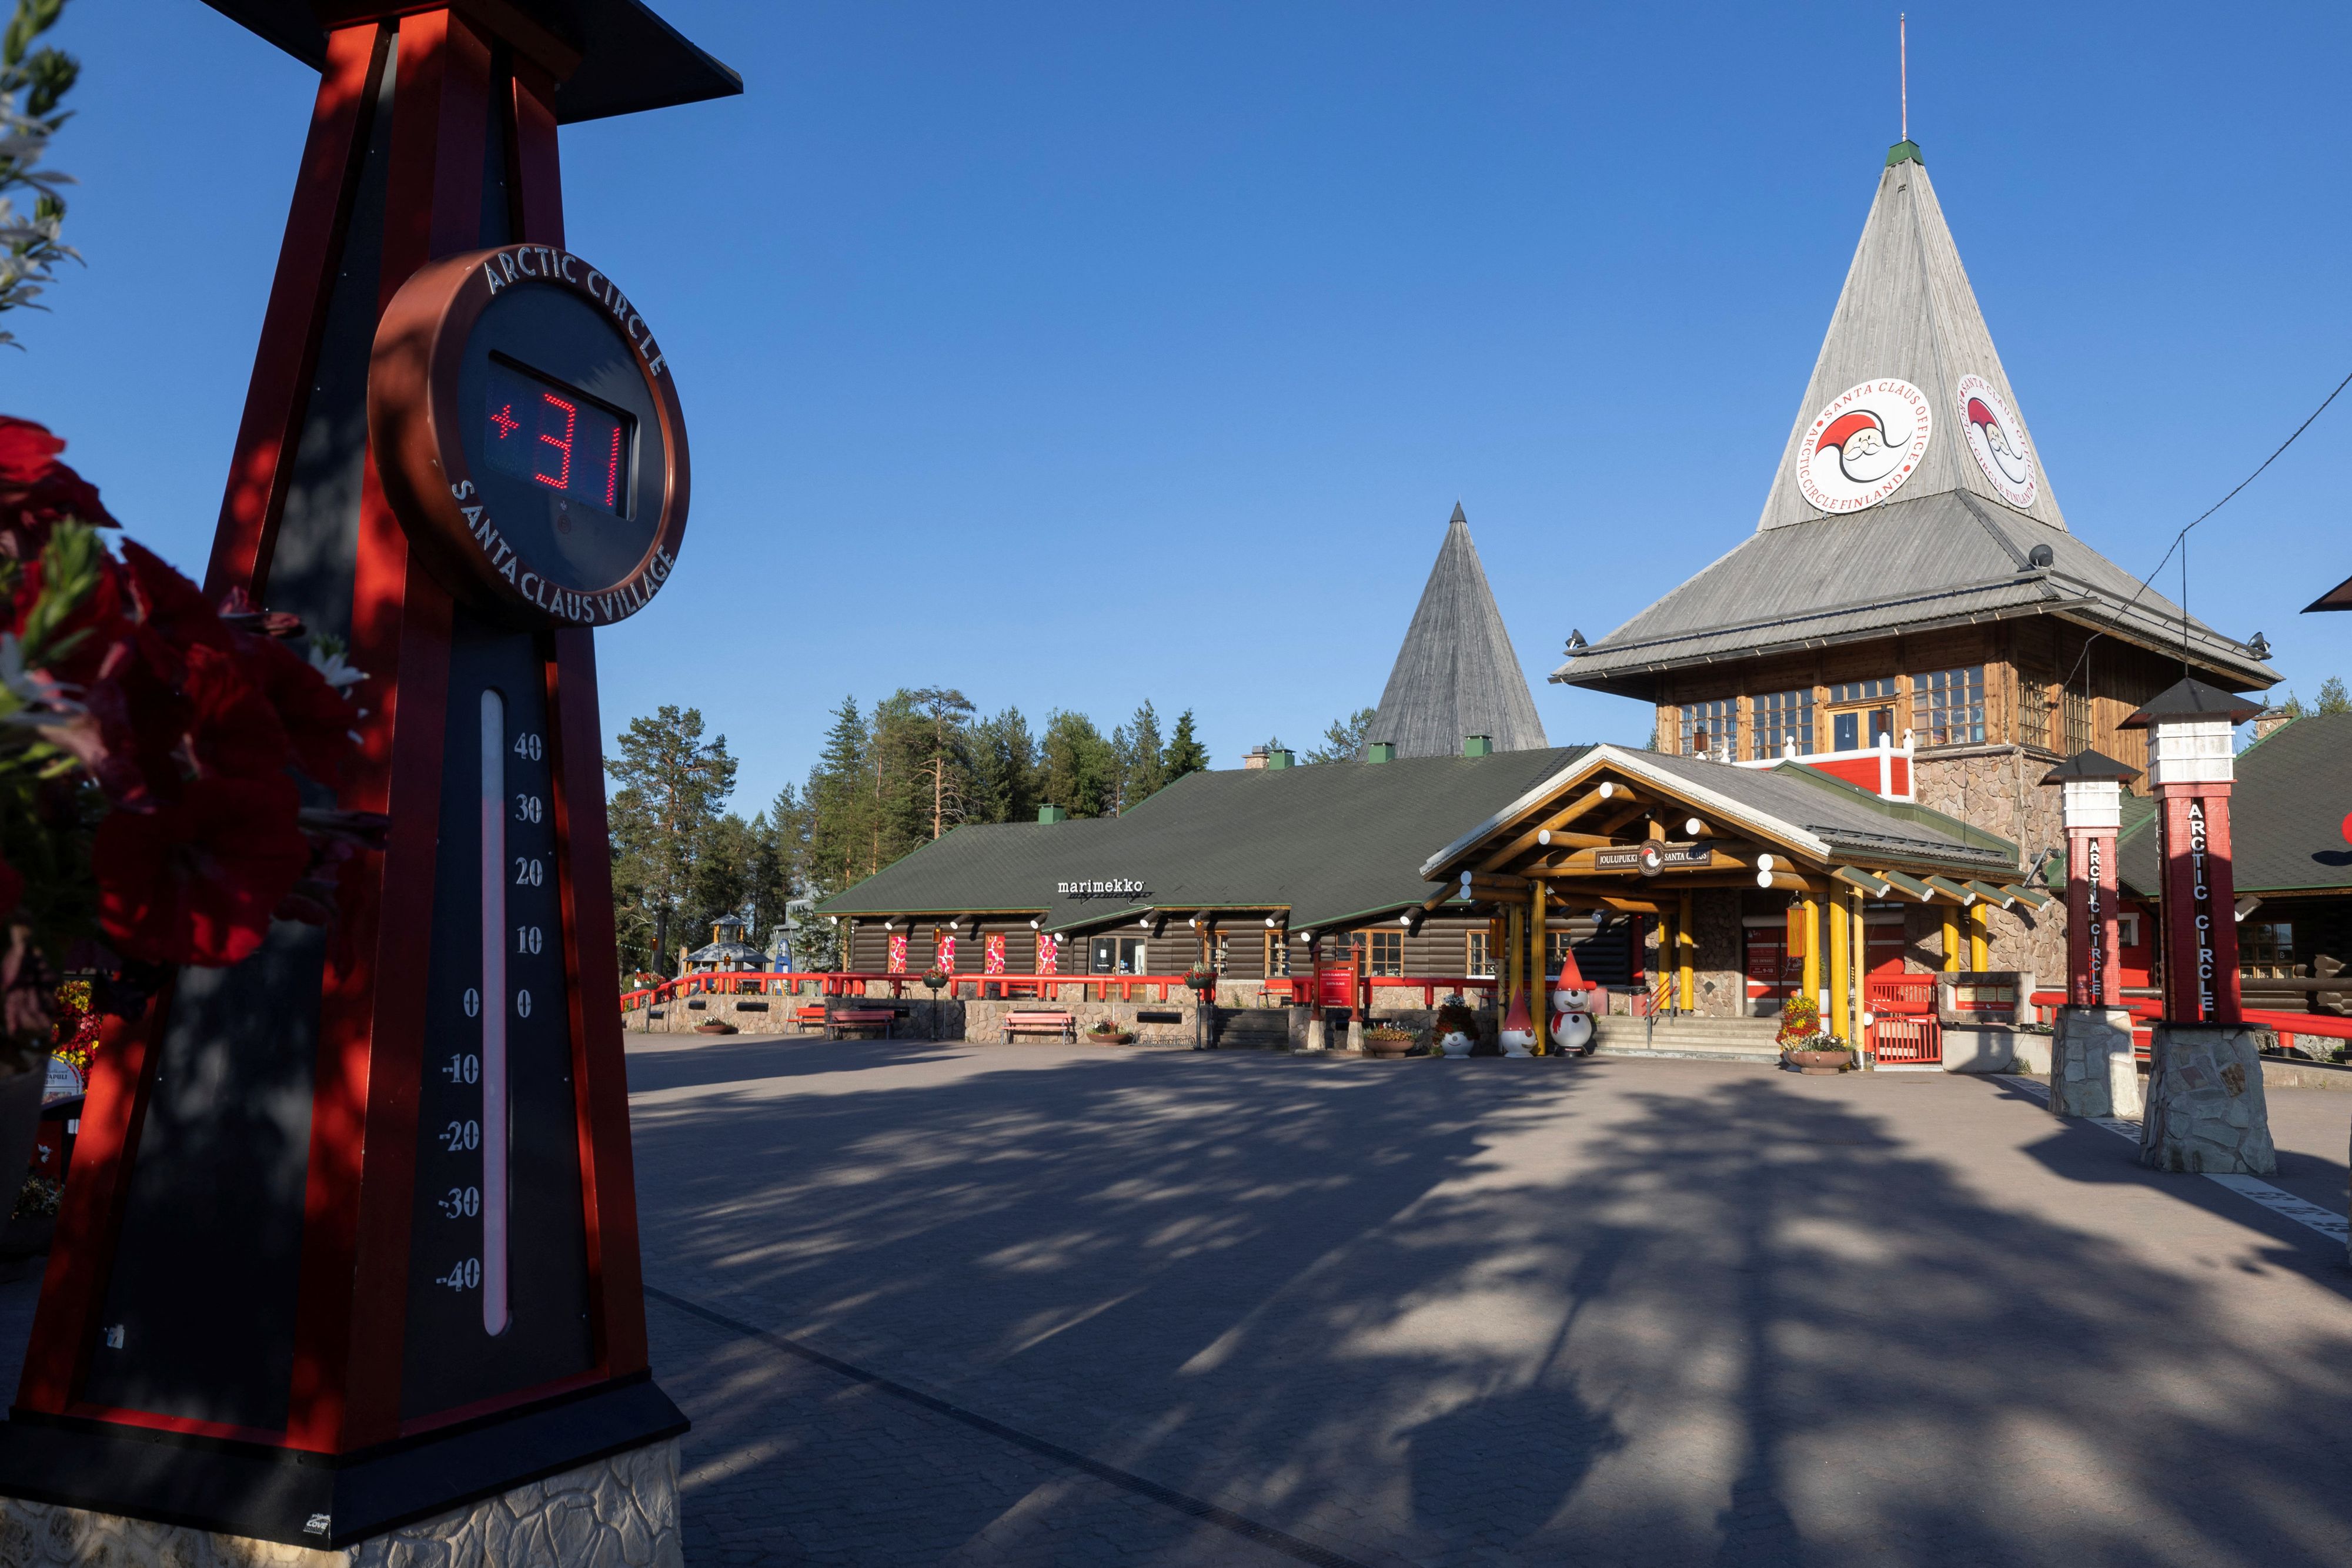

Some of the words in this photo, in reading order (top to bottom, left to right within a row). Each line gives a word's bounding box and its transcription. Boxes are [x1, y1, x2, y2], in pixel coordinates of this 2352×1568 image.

[484, 247, 577, 295] ARCTIC
[587, 270, 666, 377] CIRCLE
[1825, 385, 1873, 419] SANTA
[1879, 382, 1920, 405] CLAUS
[1909, 406, 1928, 462] OFFICE
[1962, 377, 1985, 394] SANTA
[1986, 386, 2015, 424] CLAUS
[2016, 429, 2034, 483] OFFICE
[1798, 427, 1820, 479] ARCTIC
[1958, 396, 1976, 445] ARCTIC
[1975, 447, 2004, 494] CIRCLE
[2005, 487, 2033, 510] FINLAND
[1803, 480, 1839, 509] CIRCLE
[1840, 473, 1903, 510] FINLAND
[450, 479, 517, 585] SANTA
[521, 572, 595, 623] CLAUS
[597, 544, 675, 621] VILLAGE
[514, 733, 542, 761] 40
[515, 794, 542, 823] 30
[1600, 854, 1638, 865] JOULUPUKKI
[1665, 852, 1685, 861] SANTA
[2187, 804, 2208, 901] ARCTIC
[516, 857, 543, 887] 20
[1058, 878, 1143, 893] marimekko
[2089, 841, 2100, 913] ARCTIC
[517, 925, 542, 954] 10
[2090, 924, 2101, 995] CIRCLE
[2194, 914, 2214, 1012] CIRCLE
[463, 988, 479, 1017] 0
[517, 989, 532, 1018] 0
[442, 1054, 479, 1084] -10
[439, 1120, 479, 1151] -20
[438, 1186, 479, 1218] -30
[436, 1258, 480, 1292] -40
